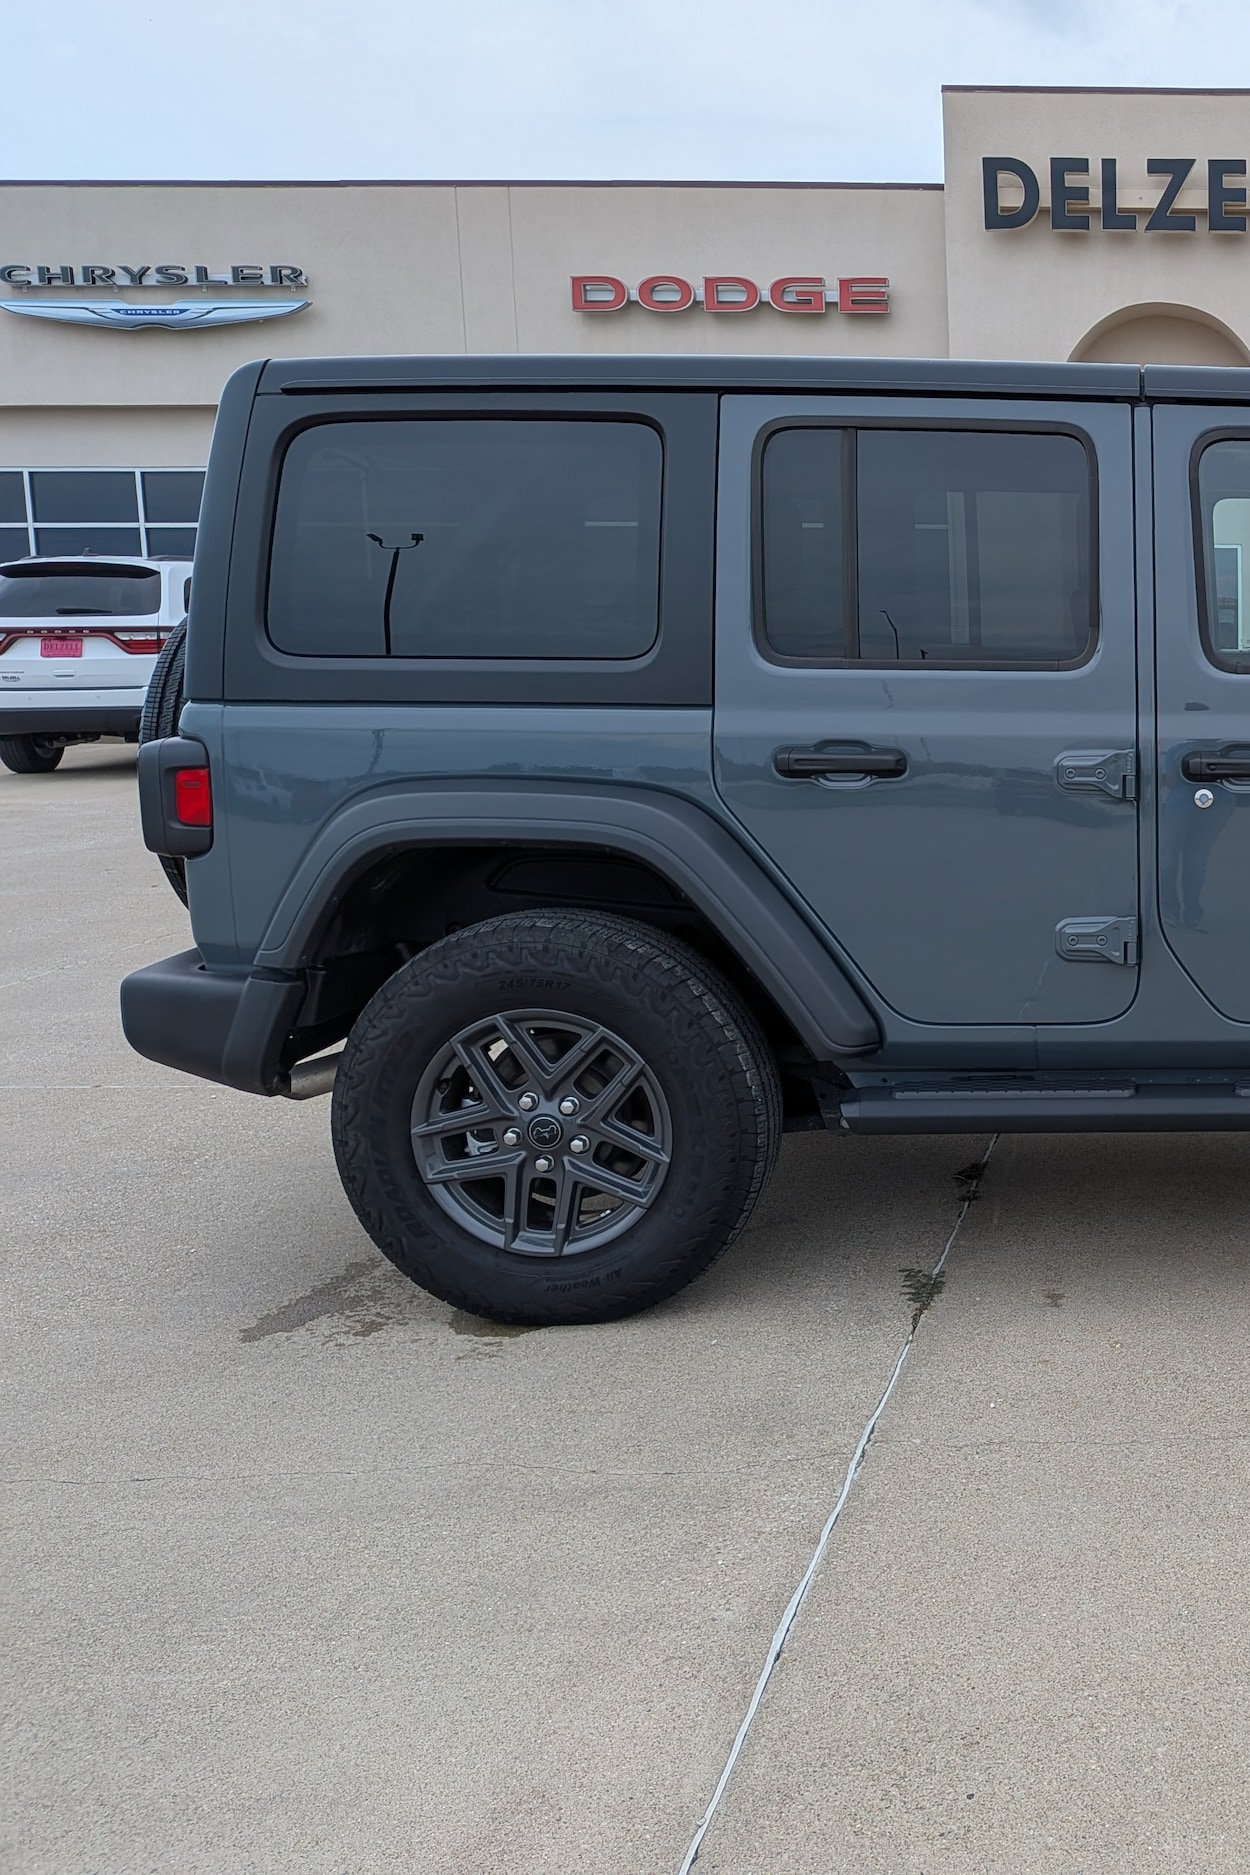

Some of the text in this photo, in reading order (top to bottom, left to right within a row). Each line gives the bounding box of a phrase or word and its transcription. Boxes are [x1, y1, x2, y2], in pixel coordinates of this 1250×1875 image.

[0, 265, 307, 286] CHRYSLER
[570, 276, 890, 313] DODGE
[43, 641, 80, 651] DELZELL
